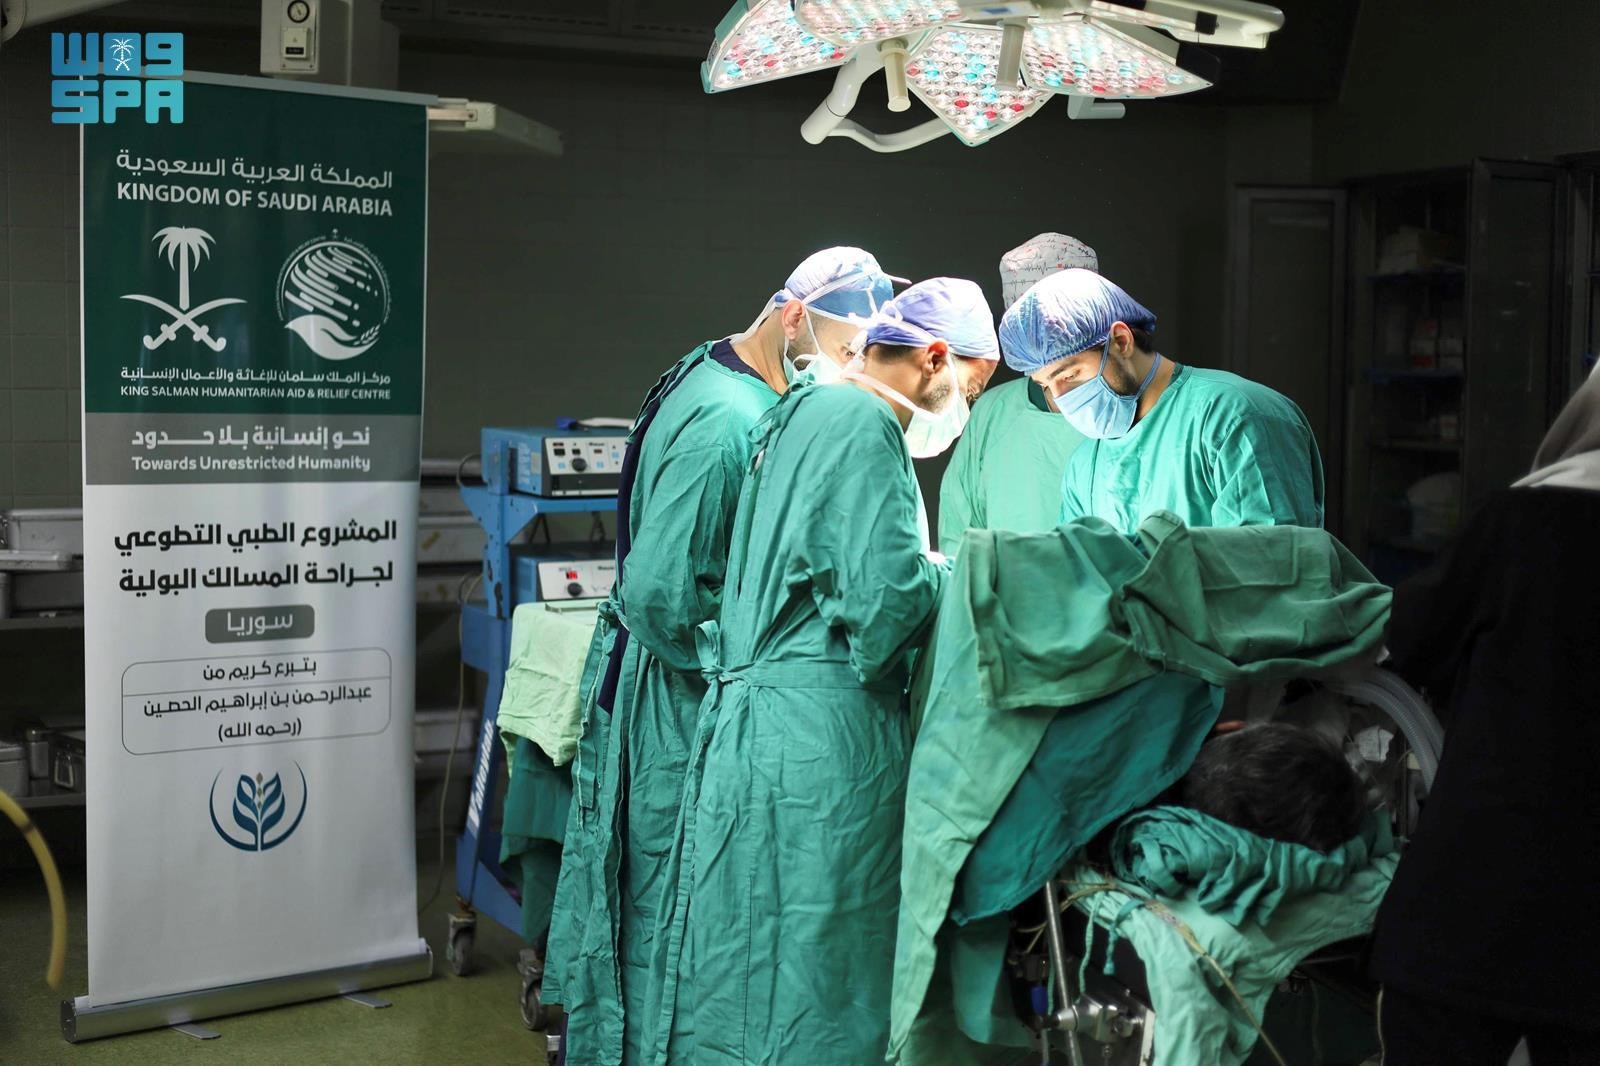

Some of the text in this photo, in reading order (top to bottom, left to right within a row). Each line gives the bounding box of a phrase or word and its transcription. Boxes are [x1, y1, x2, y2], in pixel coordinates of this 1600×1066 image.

[116, 149, 392, 188] المملكة العربية السعودية
[117, 182, 393, 217] KINGDOM OF SAUDI ARABIA
[120, 366, 391, 386] مركز الملك سلمان للإغاثة والأعمال الإنسانية
[120, 385, 391, 401] KING SALMAN HUMANITARIAN AID & RELIEF CENTRE
[131, 424, 370, 450] نحو إنسانية بلا حدود
[131, 454, 371, 473] Towards Unrestricted Humanity
[114, 517, 397, 557] المشروع الطبي التطوعي
[119, 560, 393, 598] لجراحة المسالك البولية
[226, 611, 294, 637] سوريا
[202, 656, 317, 681] بتبرع كريم من
[143, 685, 372, 719] عبدالرحمن بن إبراهيم الحصين
[218, 717, 303, 743] (رحمه الله)
